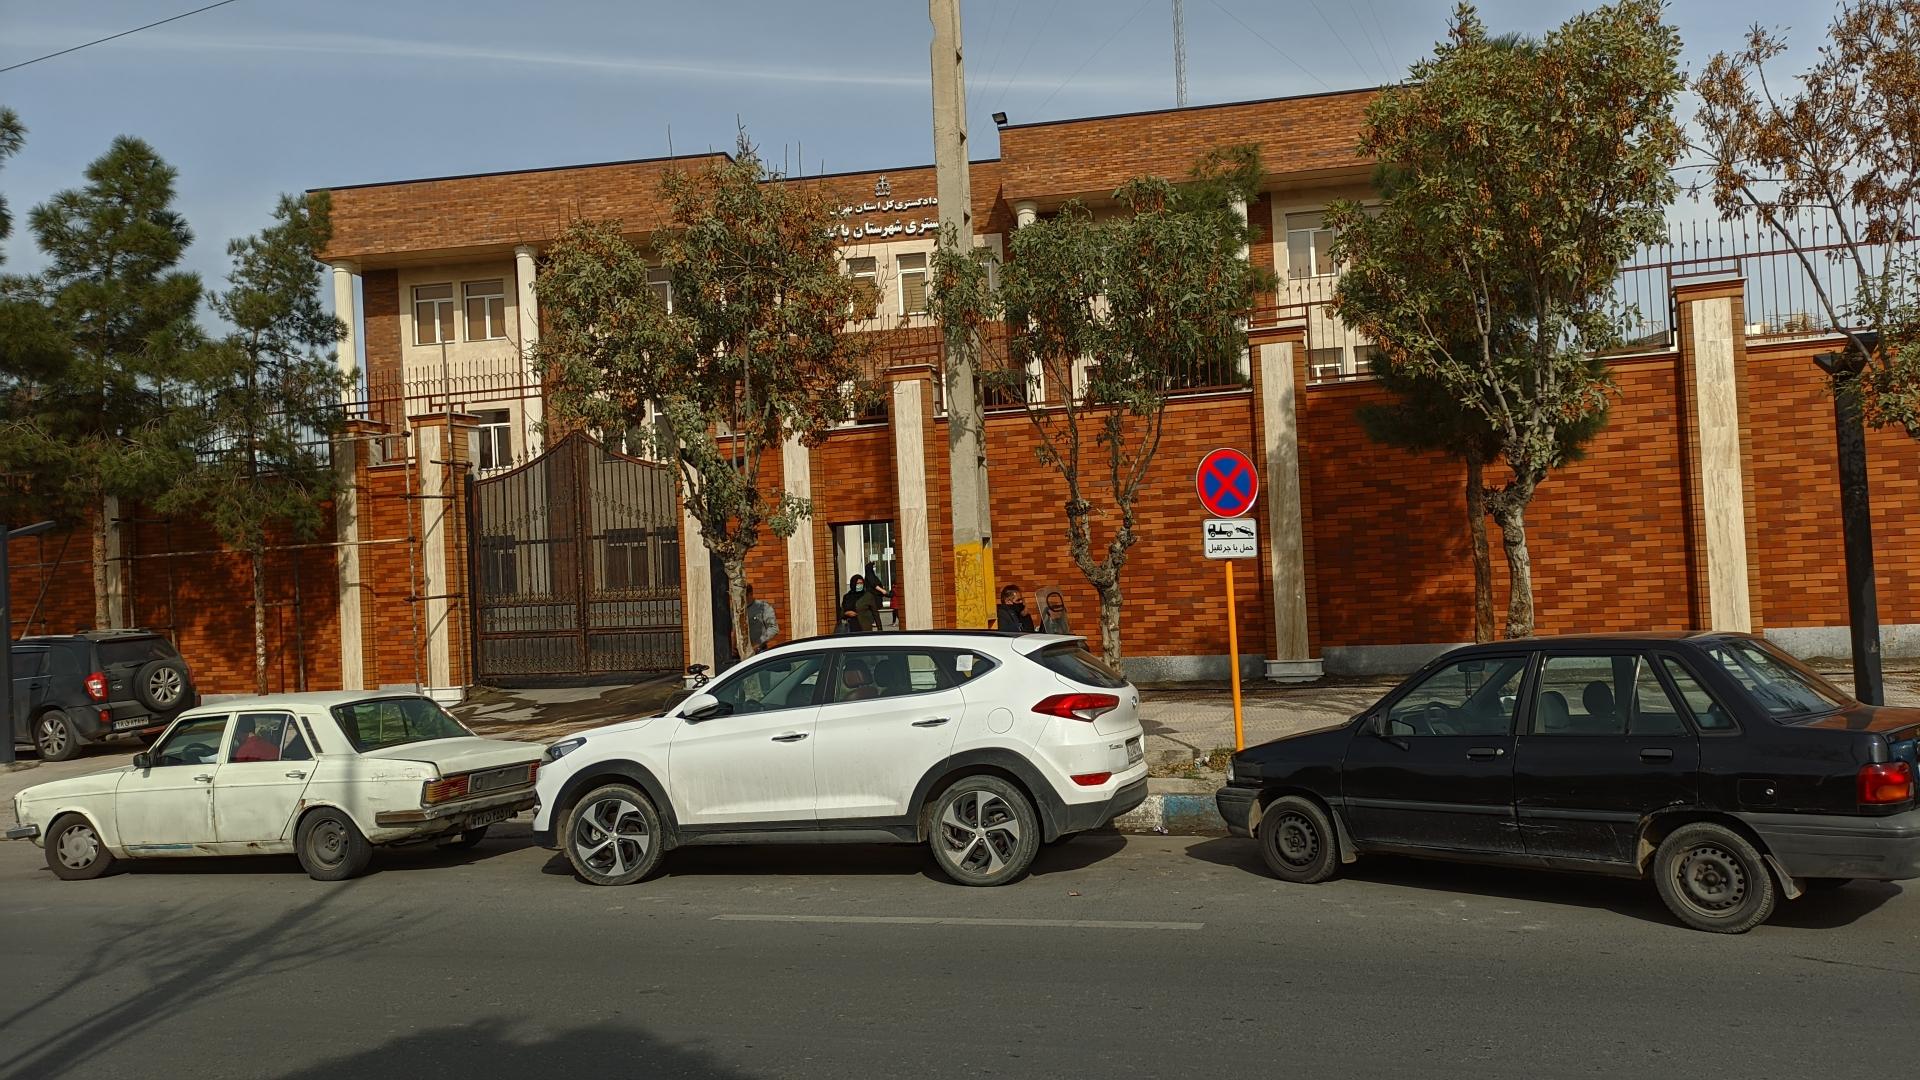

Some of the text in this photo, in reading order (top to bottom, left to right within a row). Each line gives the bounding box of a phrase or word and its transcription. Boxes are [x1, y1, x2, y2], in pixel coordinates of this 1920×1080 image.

[855, 201, 880, 213] استان
[882, 199, 895, 211] کل
[853, 219, 903, 238] شهرستان
[1232, 543, 1238, 553] با
[1240, 543, 1254, 553] حمل
